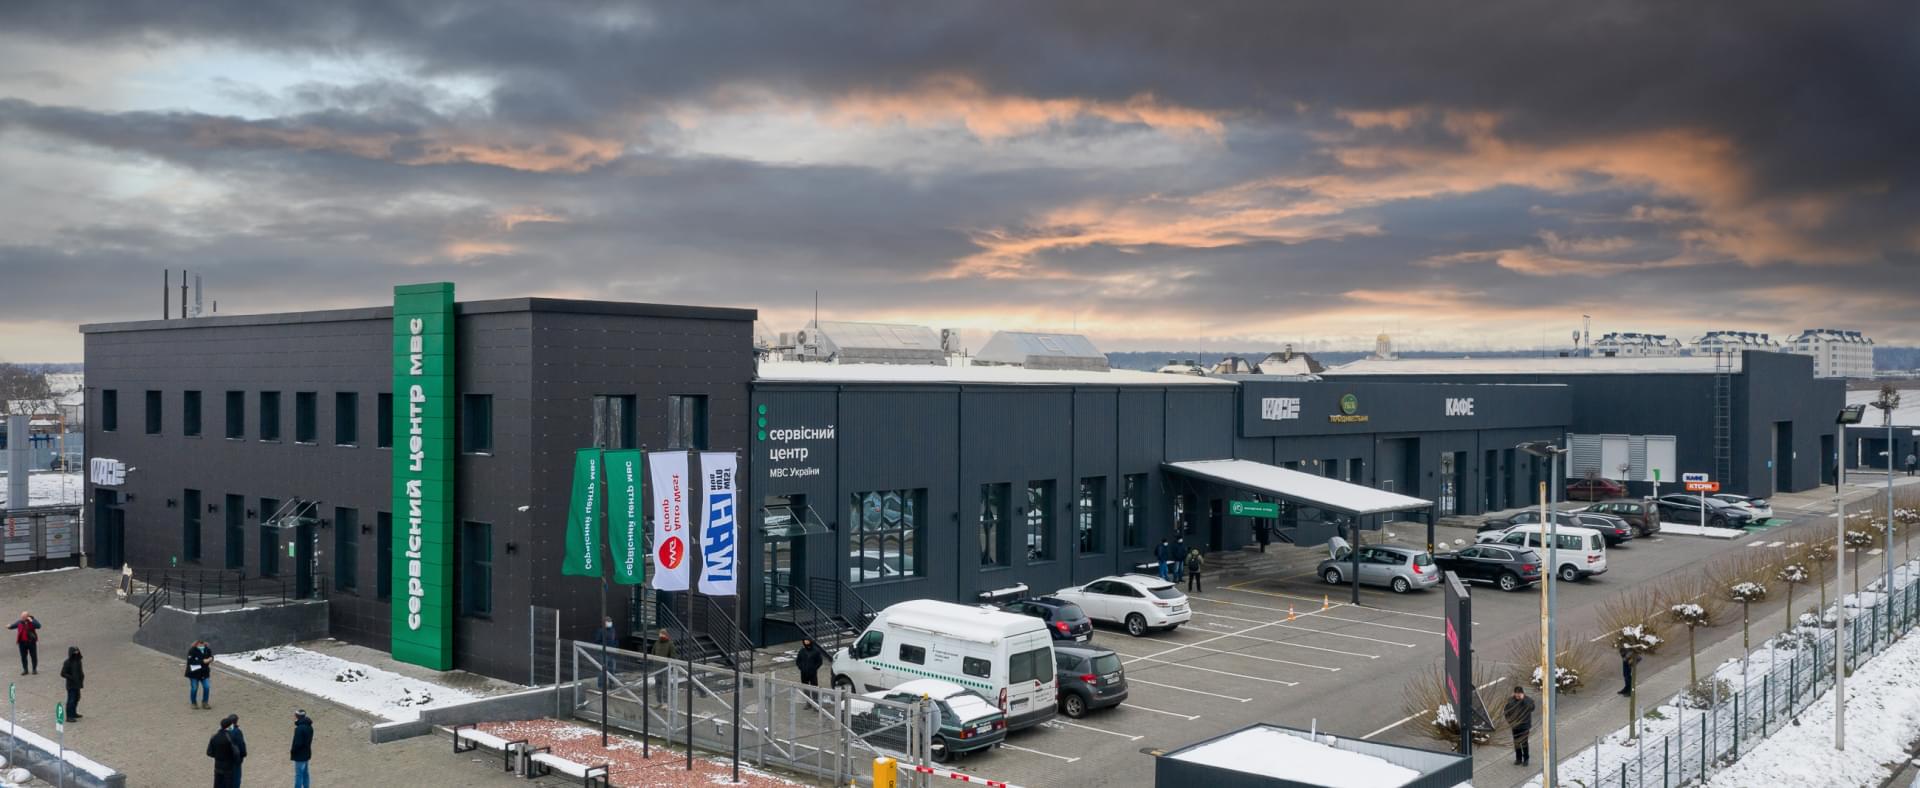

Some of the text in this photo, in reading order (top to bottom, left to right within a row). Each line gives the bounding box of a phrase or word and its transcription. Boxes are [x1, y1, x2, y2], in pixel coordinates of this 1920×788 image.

[1445, 397, 1475, 417] КАФЕ
[409, 385, 426, 471] центр
[770, 425, 834, 443] сервісний
[770, 448, 808, 461] центр
[769, 466, 820, 479] МВС України
